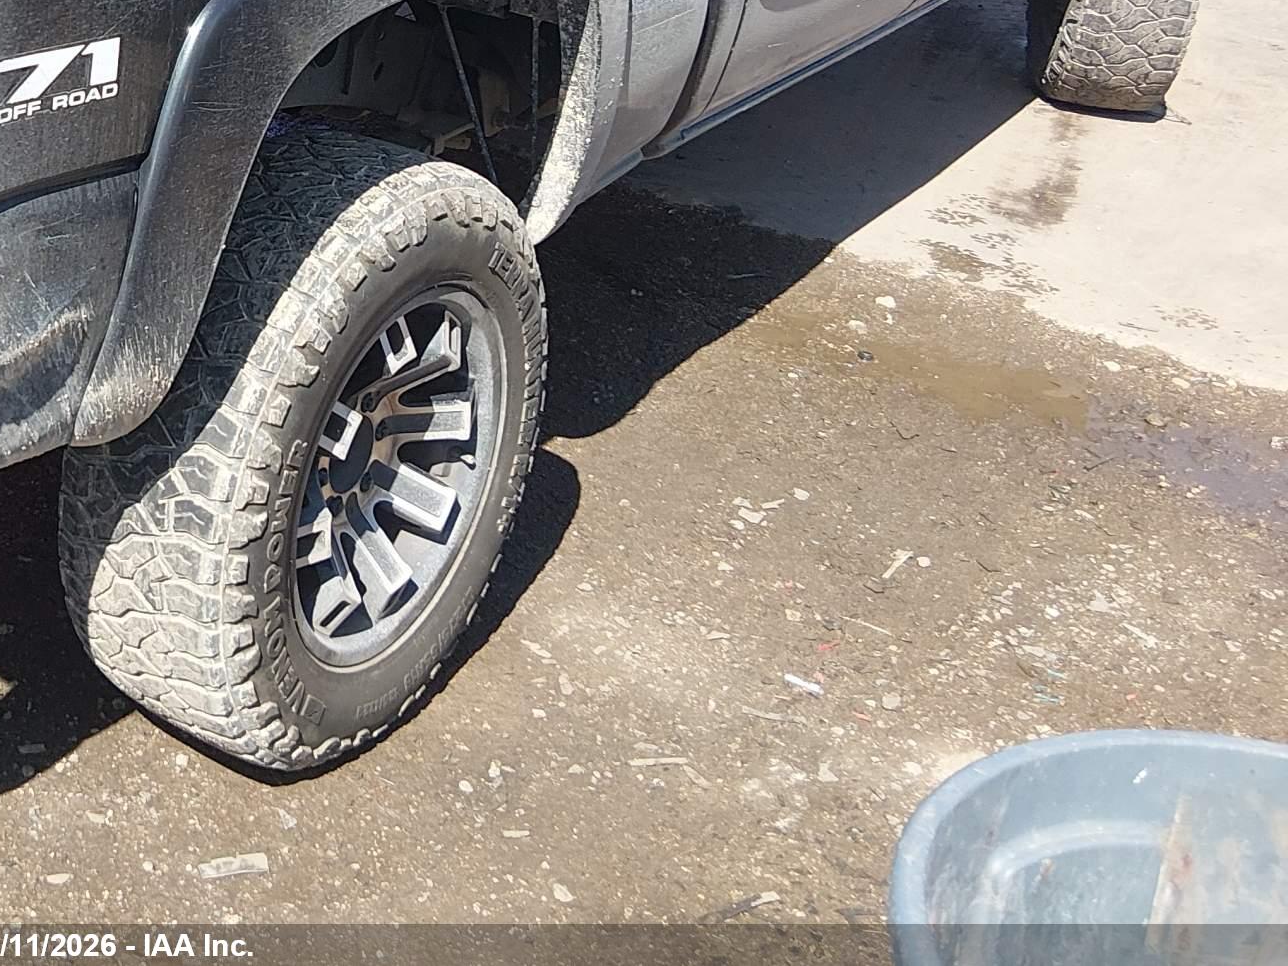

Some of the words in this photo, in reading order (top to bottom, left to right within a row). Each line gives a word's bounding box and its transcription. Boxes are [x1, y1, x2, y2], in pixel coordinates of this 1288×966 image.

[51, 83, 119, 111] ROAD
[264, 438, 308, 593] POWER
[264, 597, 304, 714] VENOM
